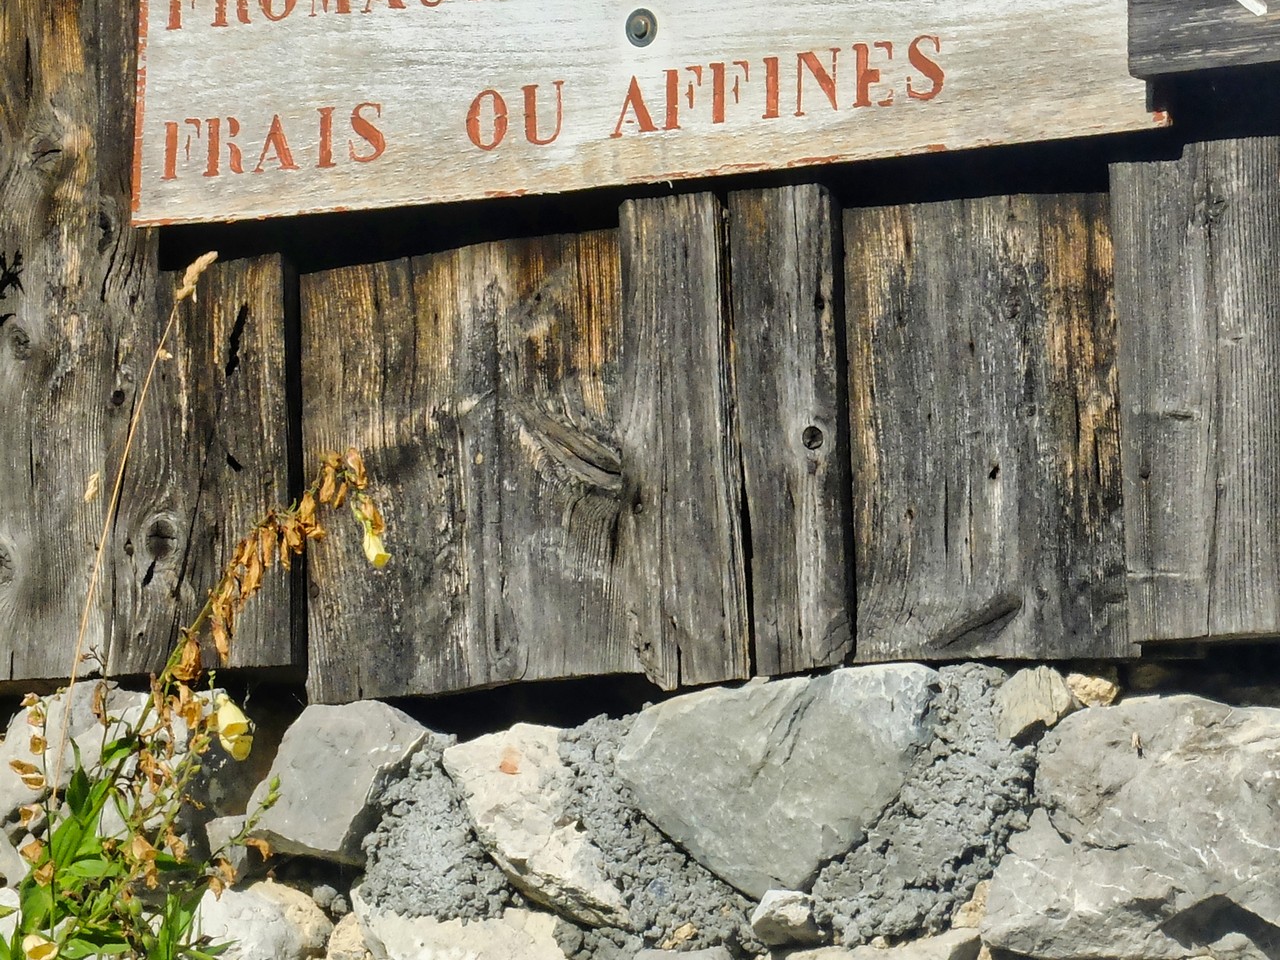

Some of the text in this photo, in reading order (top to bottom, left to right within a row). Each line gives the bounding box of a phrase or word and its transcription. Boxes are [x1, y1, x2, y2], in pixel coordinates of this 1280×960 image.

[161, 35, 945, 180] FRAIS OU AFFINES
